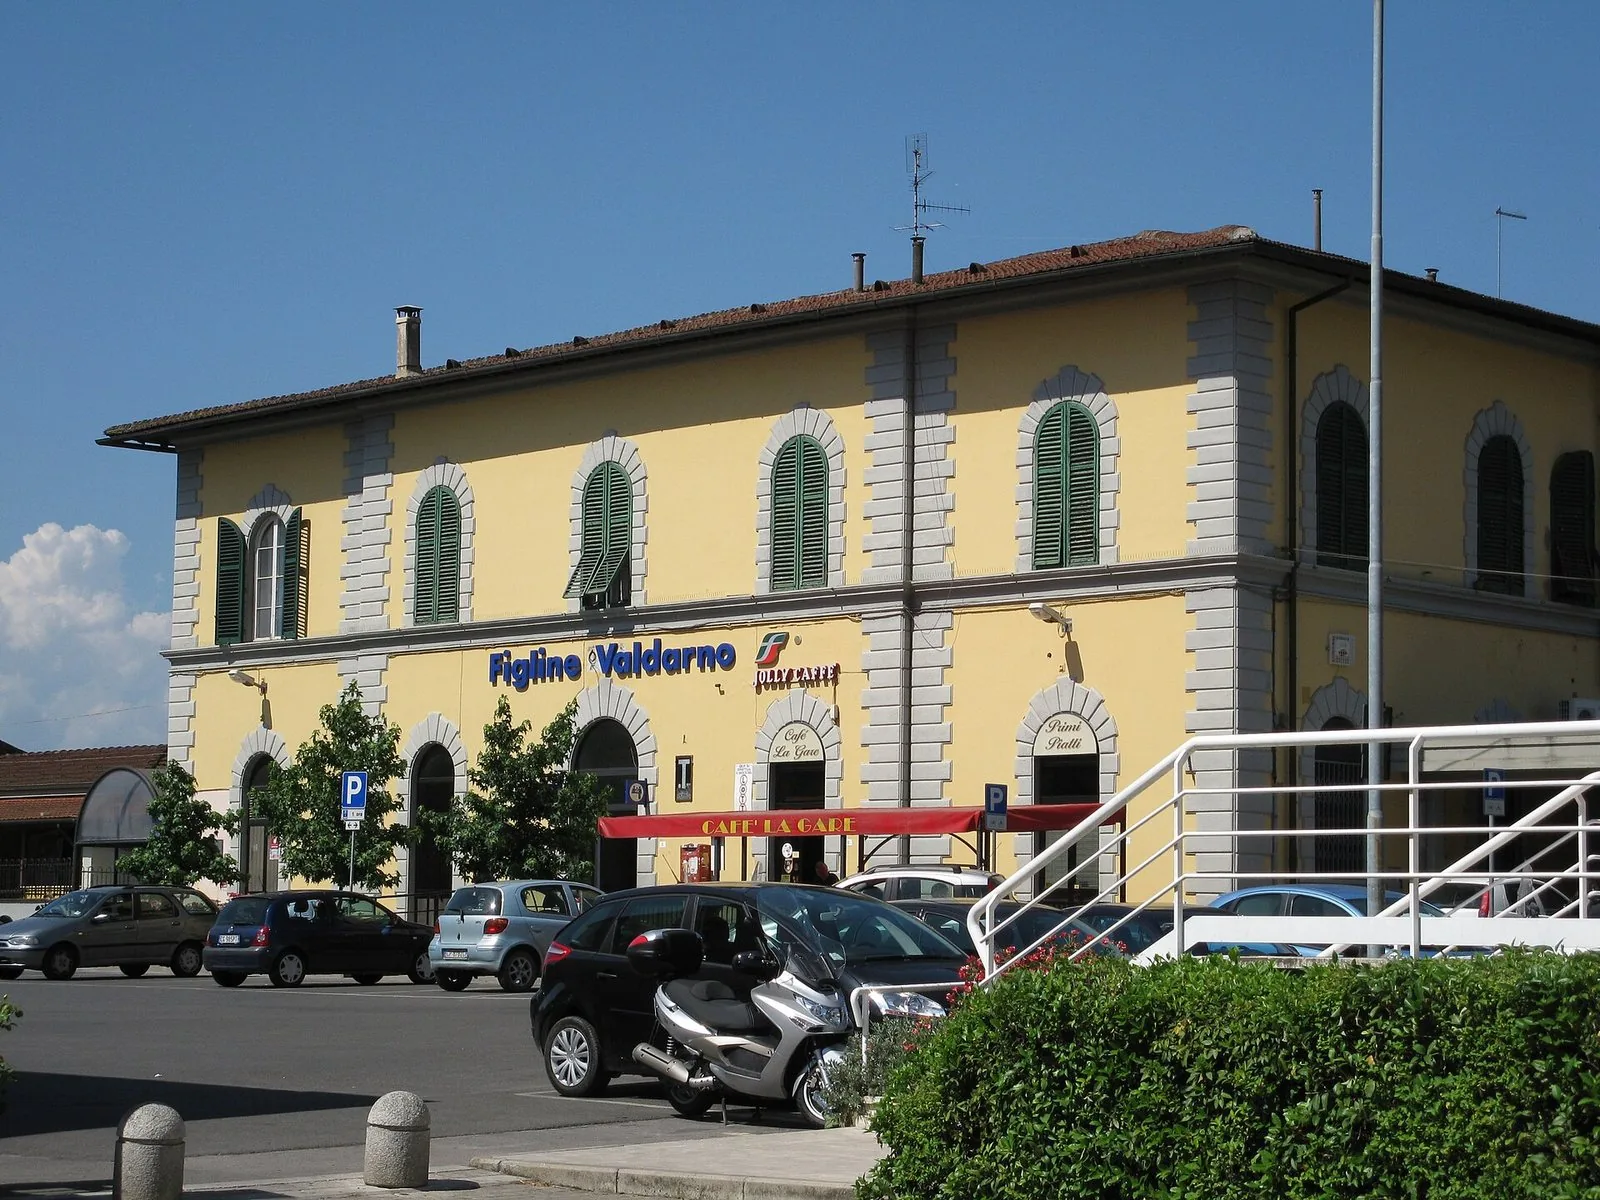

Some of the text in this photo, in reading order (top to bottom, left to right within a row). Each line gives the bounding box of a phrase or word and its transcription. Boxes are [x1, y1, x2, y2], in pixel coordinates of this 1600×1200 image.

[489, 638, 736, 692] Figline Valdarno
[753, 669, 789, 687] JOLLY
[1045, 719, 1082, 733] Primi
[784, 728, 809, 744] Café
[1045, 736, 1082, 750] Piatti
[773, 744, 820, 760] La Gare
[678, 759, 690, 789] T
[346, 775, 362, 805] P
[1488, 771, 1501, 797] P
[990, 787, 1004, 811] P
[702, 817, 857, 835] CAFE' LA GARE
